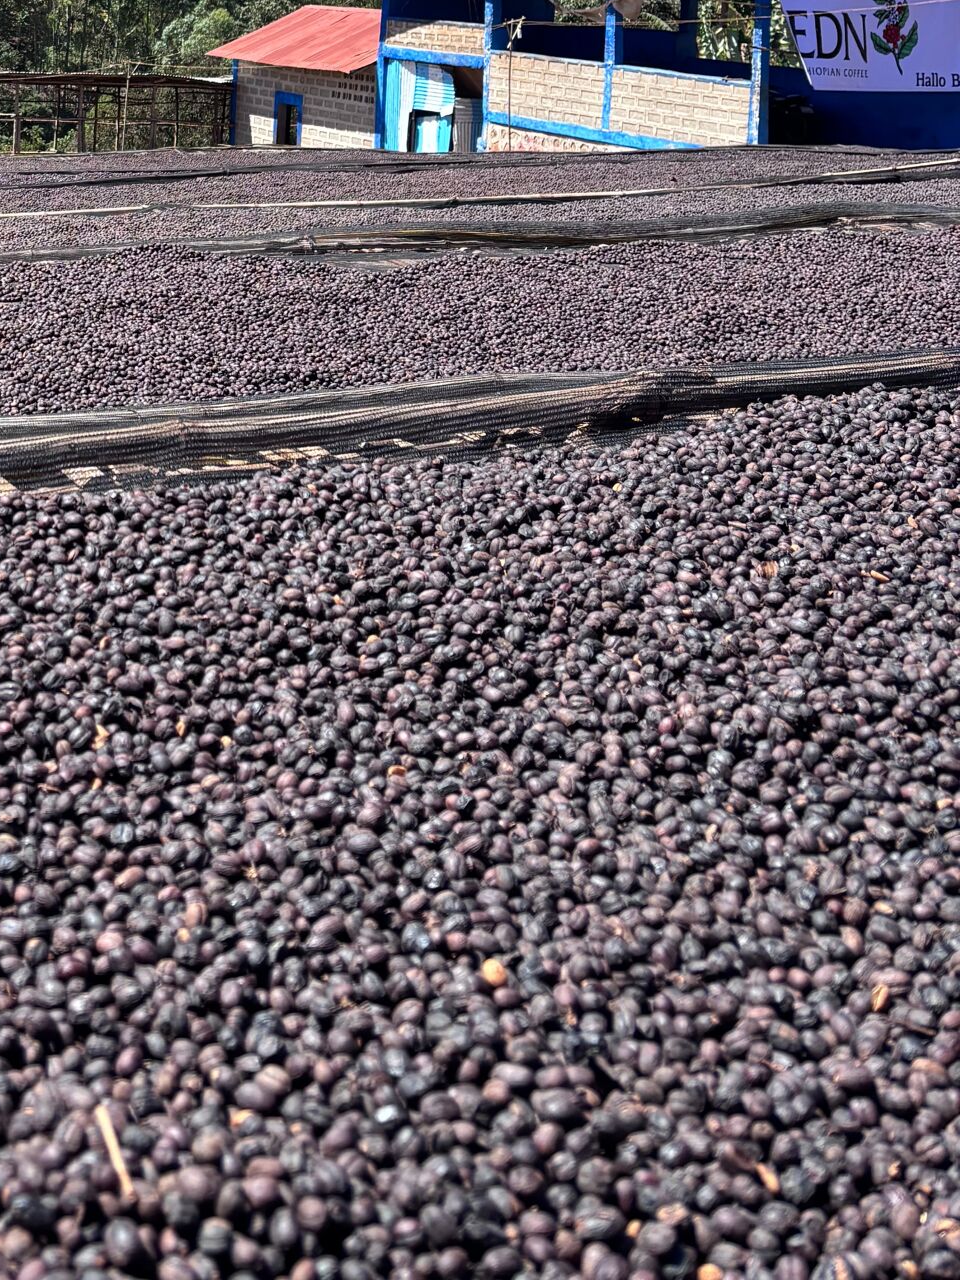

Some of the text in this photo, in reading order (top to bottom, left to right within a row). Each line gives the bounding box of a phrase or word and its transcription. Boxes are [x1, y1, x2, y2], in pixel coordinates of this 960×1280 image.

[786, 10, 868, 64] EDN
[843, 68, 869, 79] COFFEE
[916, 72, 946, 87] Hallo
